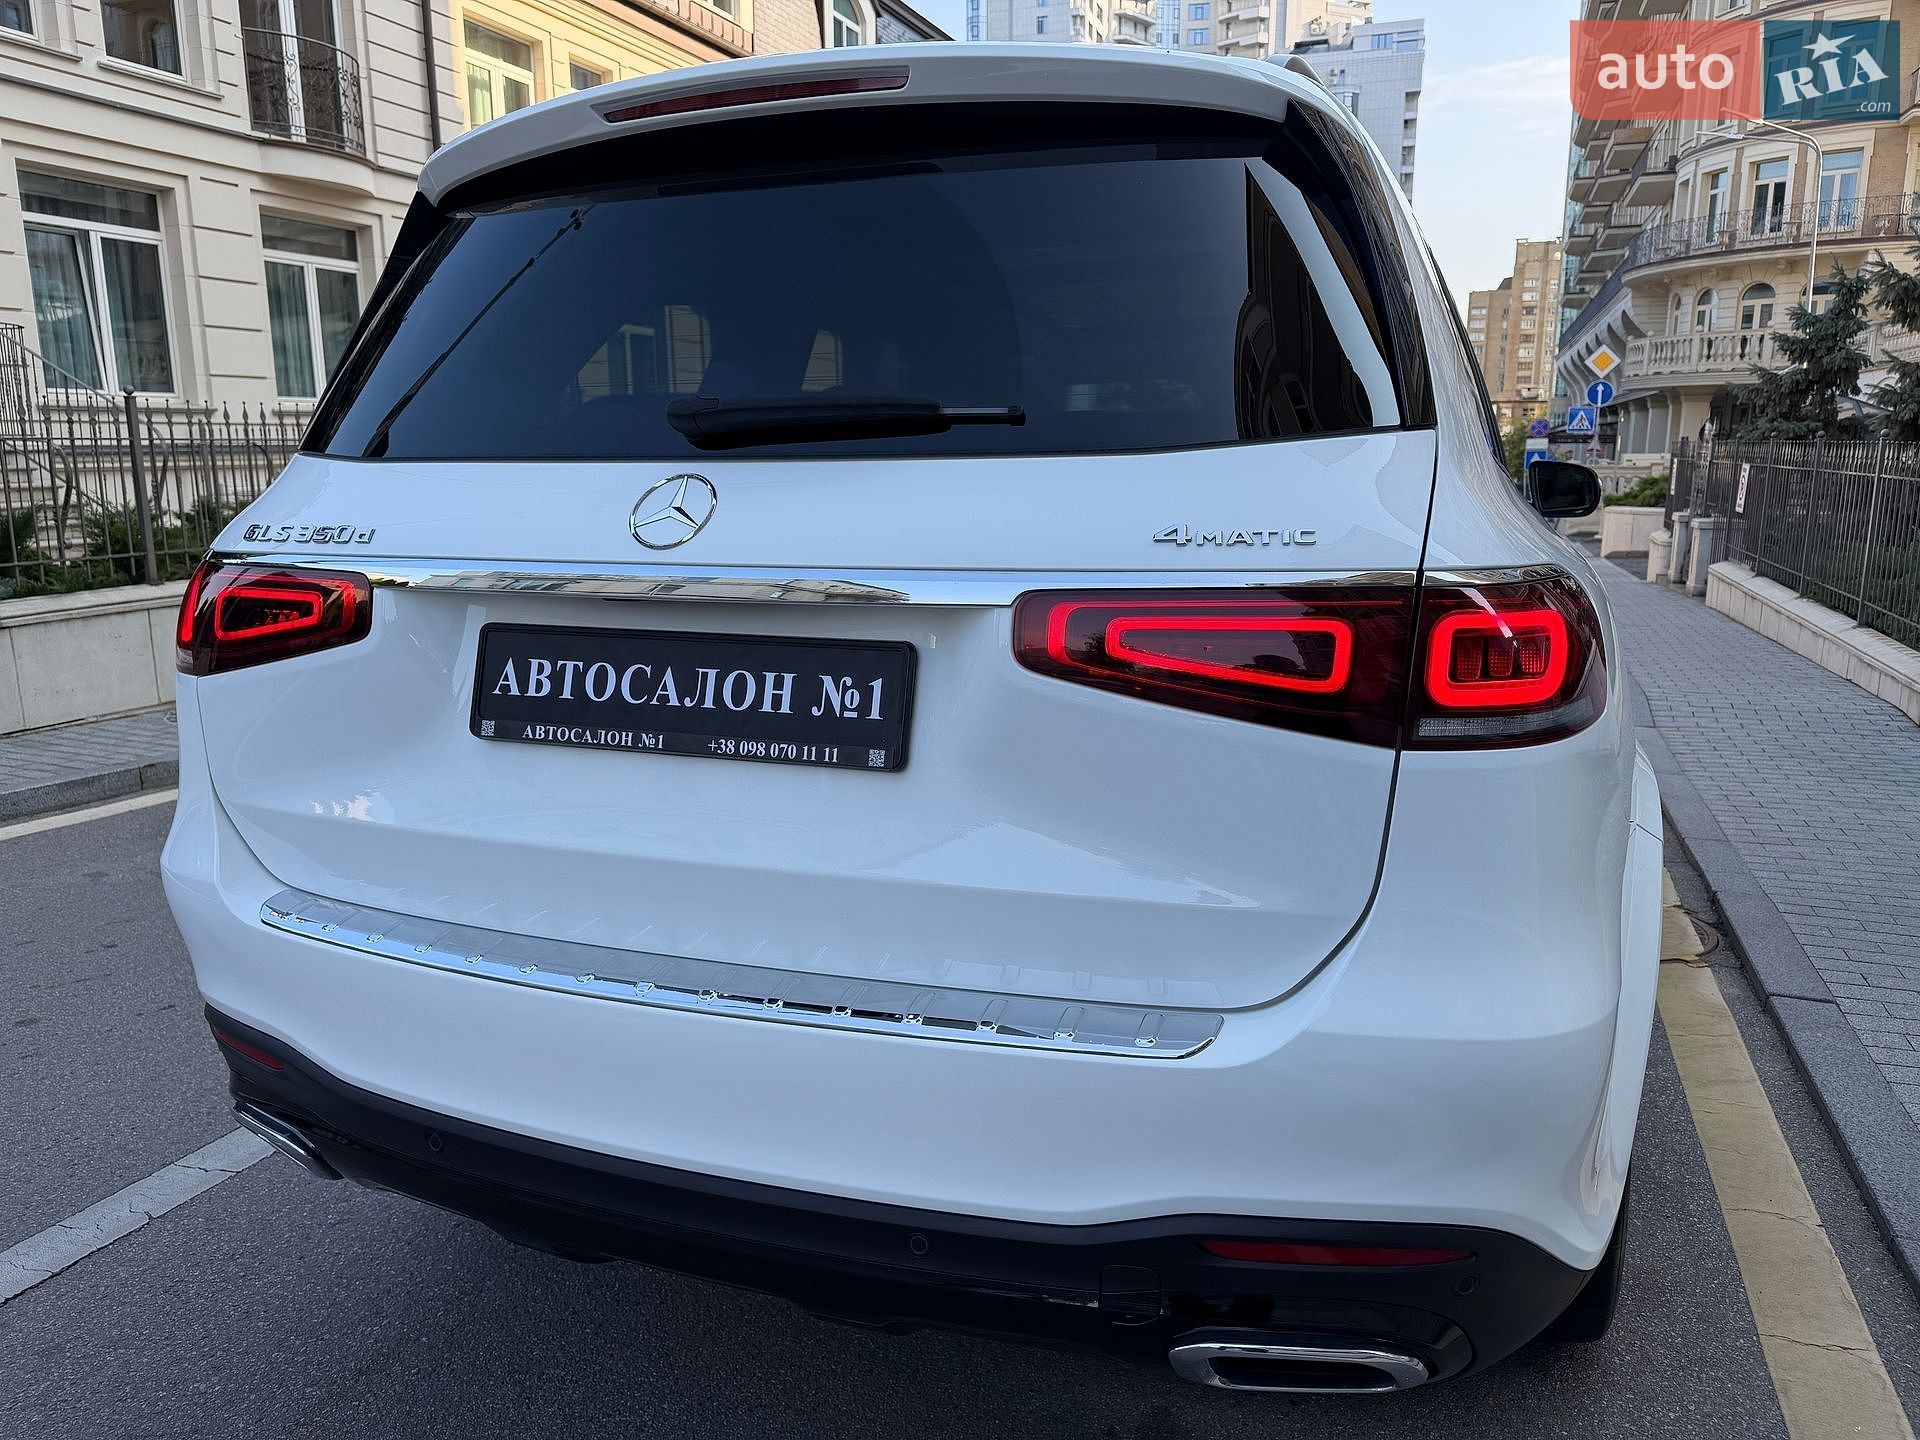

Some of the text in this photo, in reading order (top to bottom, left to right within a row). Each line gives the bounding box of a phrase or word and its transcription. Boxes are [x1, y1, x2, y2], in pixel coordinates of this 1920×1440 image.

[243, 524, 295, 543] GLS
[1152, 523, 1317, 547] 4MATIC
[492, 657, 798, 714] АВТОСАЛОН
[522, 725, 633, 747] АВТОСАЛОН
[707, 739, 839, 763] +38 098 070 11 11
